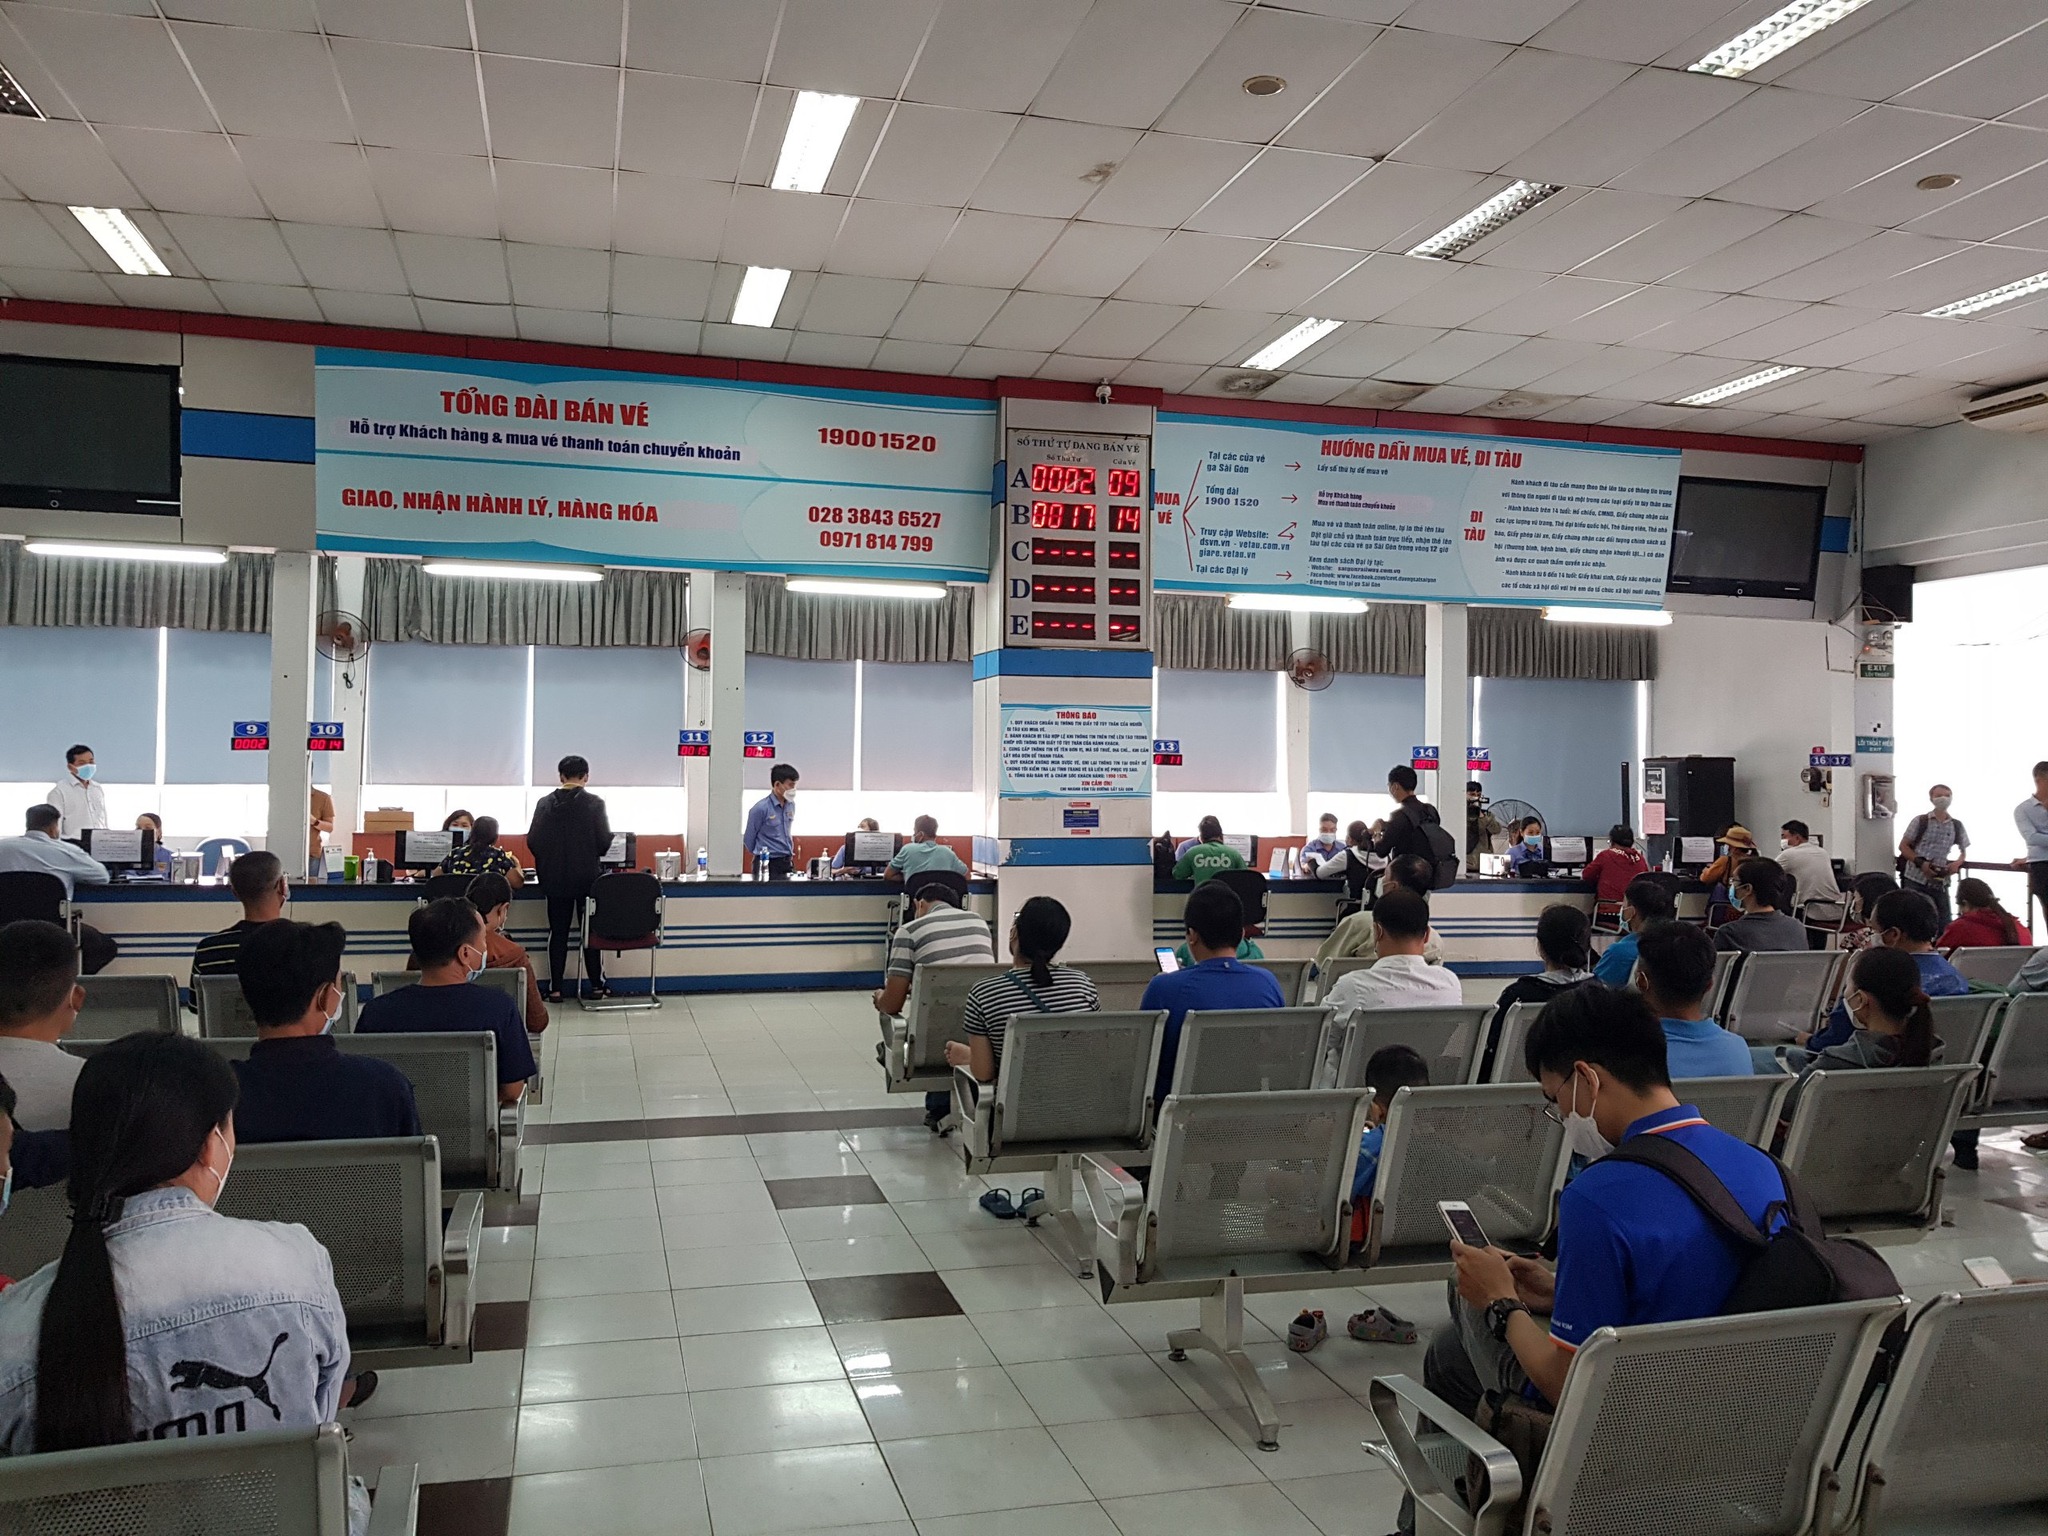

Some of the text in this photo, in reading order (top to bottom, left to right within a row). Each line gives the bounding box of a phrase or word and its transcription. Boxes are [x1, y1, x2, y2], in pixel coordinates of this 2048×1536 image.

[440, 387, 648, 426] TỔNG ĐÀI BÁN VÉ
[350, 418, 740, 460] Hỗ trợ Khách hàng & mua vé thanh toán chuyển khoản
[818, 428, 937, 452] 19001520
[1103, 442, 1123, 452] BÁN
[1321, 438, 1522, 468] HƯỚNG DẪN MUA VÉ, ĐI TÀU
[1209, 451, 1220, 461] Tại
[1222, 452, 1237, 460] các
[1011, 468, 1030, 488] A
[1032, 466, 1096, 494] 0002
[1109, 470, 1138, 496] 09
[342, 488, 657, 521] GIAO, NHẬN HÀNH LÝ, HÀNG HÓA
[1154, 492, 1180, 505] MUA
[1205, 497, 1259, 506] 1900 1520
[808, 506, 942, 528] 028 3843 6527
[1011, 504, 1030, 525] B
[1032, 502, 1095, 529] 0017
[1117, 508, 1139, 531] 14
[1158, 510, 1172, 524] VÉ
[1470, 511, 1483, 523] ĐI
[820, 530, 934, 552] 0971 814 799
[1464, 529, 1485, 541] TÀU
[1011, 541, 1030, 561] C
[1010, 579, 1030, 598] D
[1010, 615, 1028, 635] E
[1082, 711, 1096, 719] BÁO
[246, 725, 257, 734] 9
[317, 725, 336, 734] 10
[234, 739, 267, 749] 0002
[310, 740, 341, 749] 0014
[687, 733, 703, 742] 11
[751, 734, 767, 743] 12
[681, 746, 708, 755] 0015
[1159, 742, 1174, 751] 13
[1419, 748, 1433, 757] 14
[1814, 756, 1846, 765] 16 17
[1194, 853, 1231, 868] Grab
